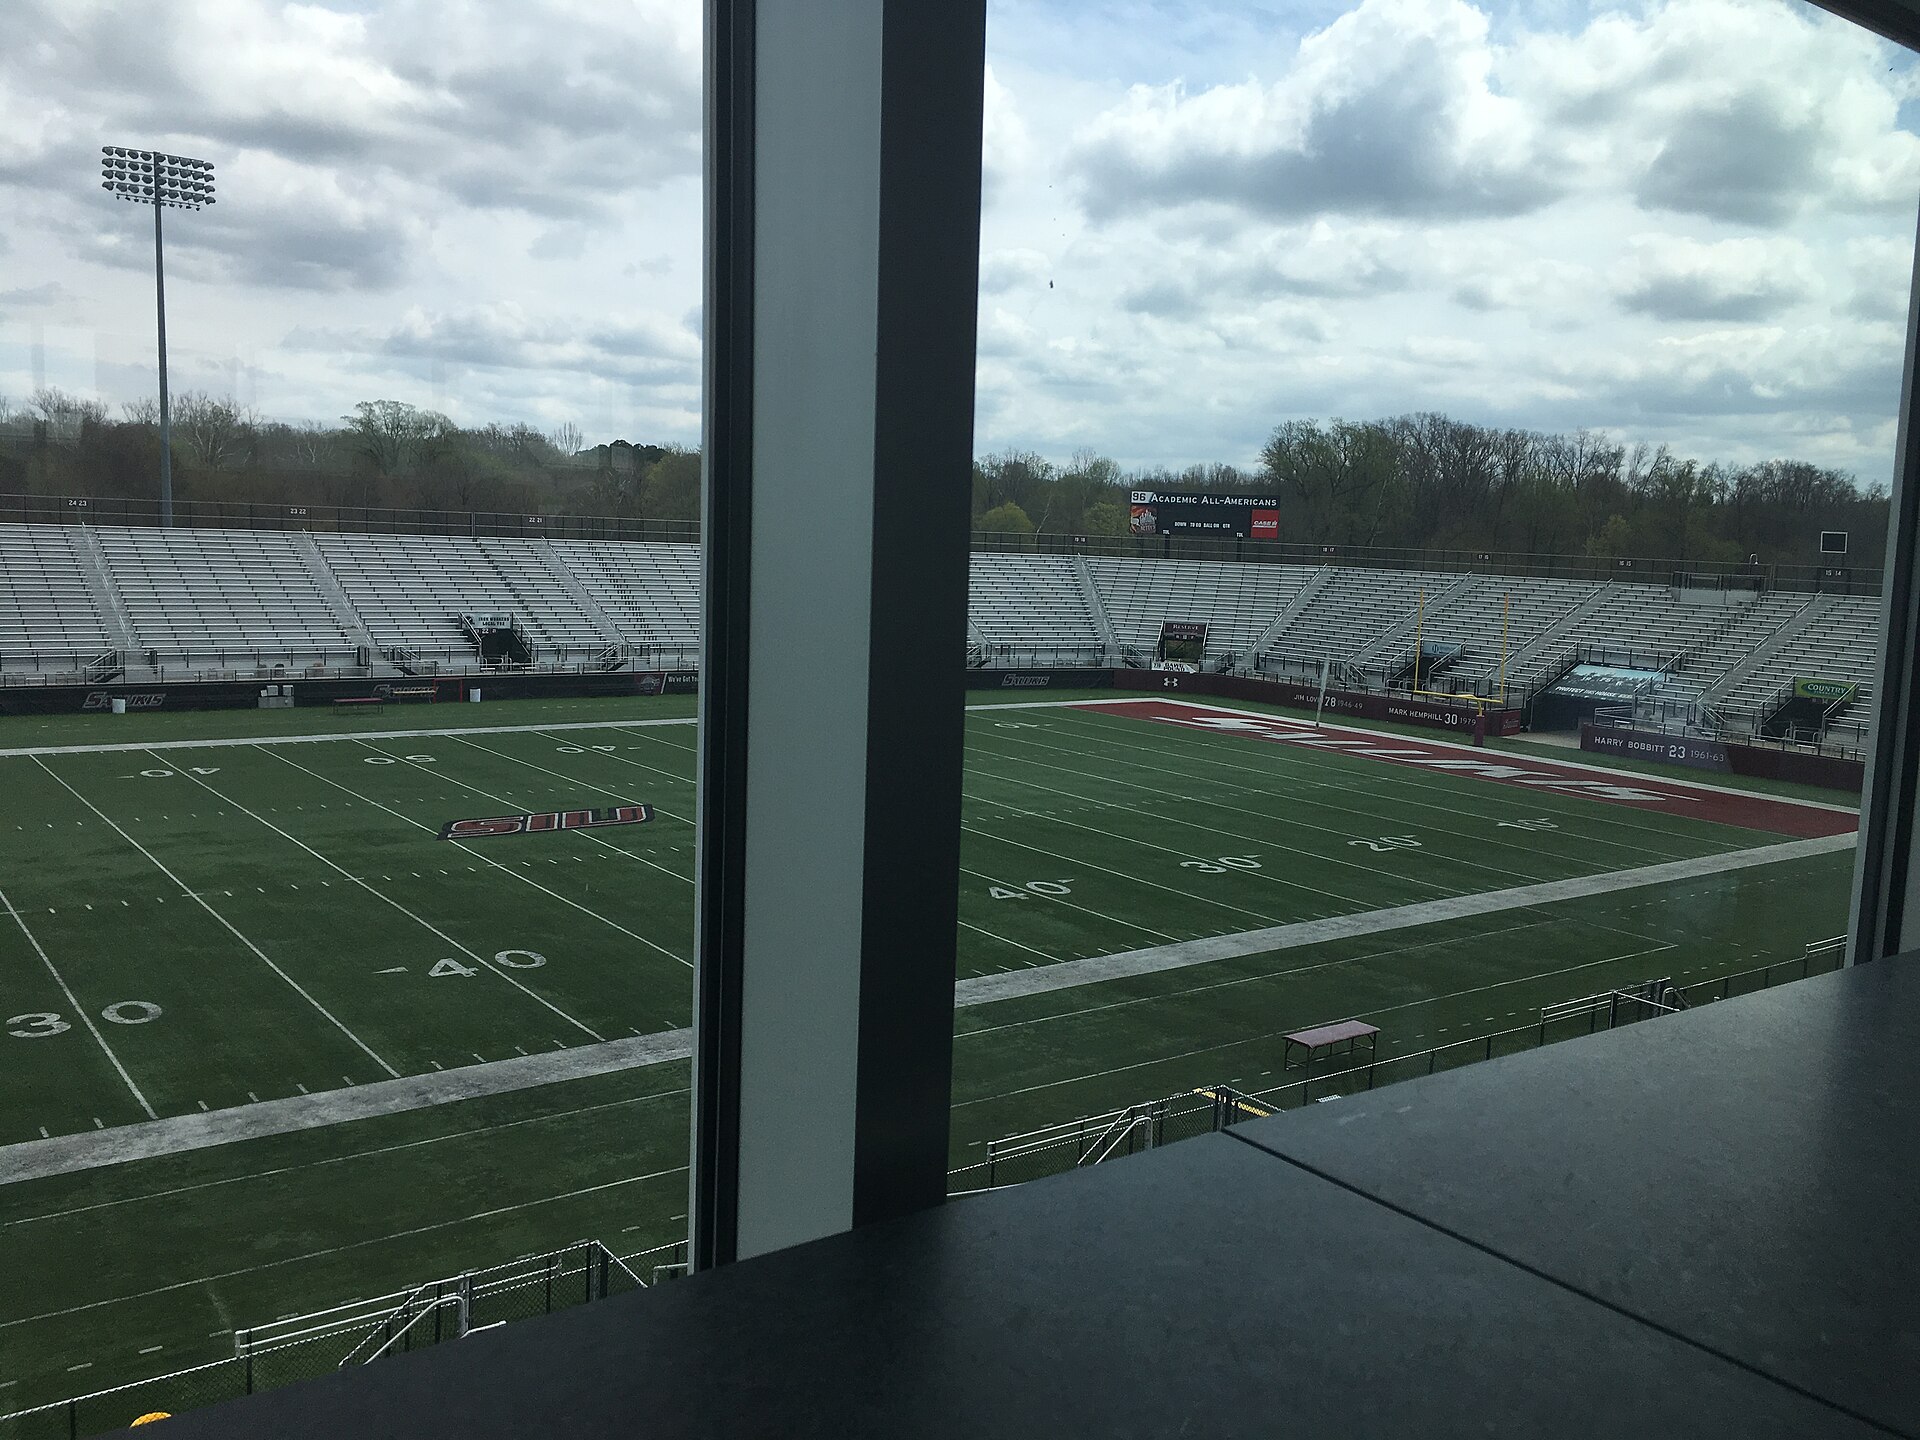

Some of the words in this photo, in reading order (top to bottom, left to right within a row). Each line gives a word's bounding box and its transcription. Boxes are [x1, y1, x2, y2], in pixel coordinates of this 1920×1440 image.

[1132, 492, 1146, 502] 96
[1151, 493, 1198, 504] ACADEMIC
[1201, 495, 1277, 506] ALL-AMERICANS
[1807, 683, 1846, 694] COUNTRY
[1324, 696, 1337, 708] 78
[1388, 707, 1408, 716] MARK
[1409, 710, 1443, 721] HEMPHILL
[1444, 713, 1458, 725] 30
[1460, 717, 1477, 726] 1979
[1594, 736, 1624, 747] HARRY
[1627, 740, 1665, 753] BOBBITT
[1668, 744, 1686, 759] 23
[1690, 749, 1725, 762] 1961-63
[437, 803, 655, 841] SIU
[1346, 835, 1424, 853] 20
[1179, 854, 1263, 875] 30
[987, 879, 1072, 902] 40
[428, 949, 548, 979] 40
[5, 1000, 163, 1039] 30
